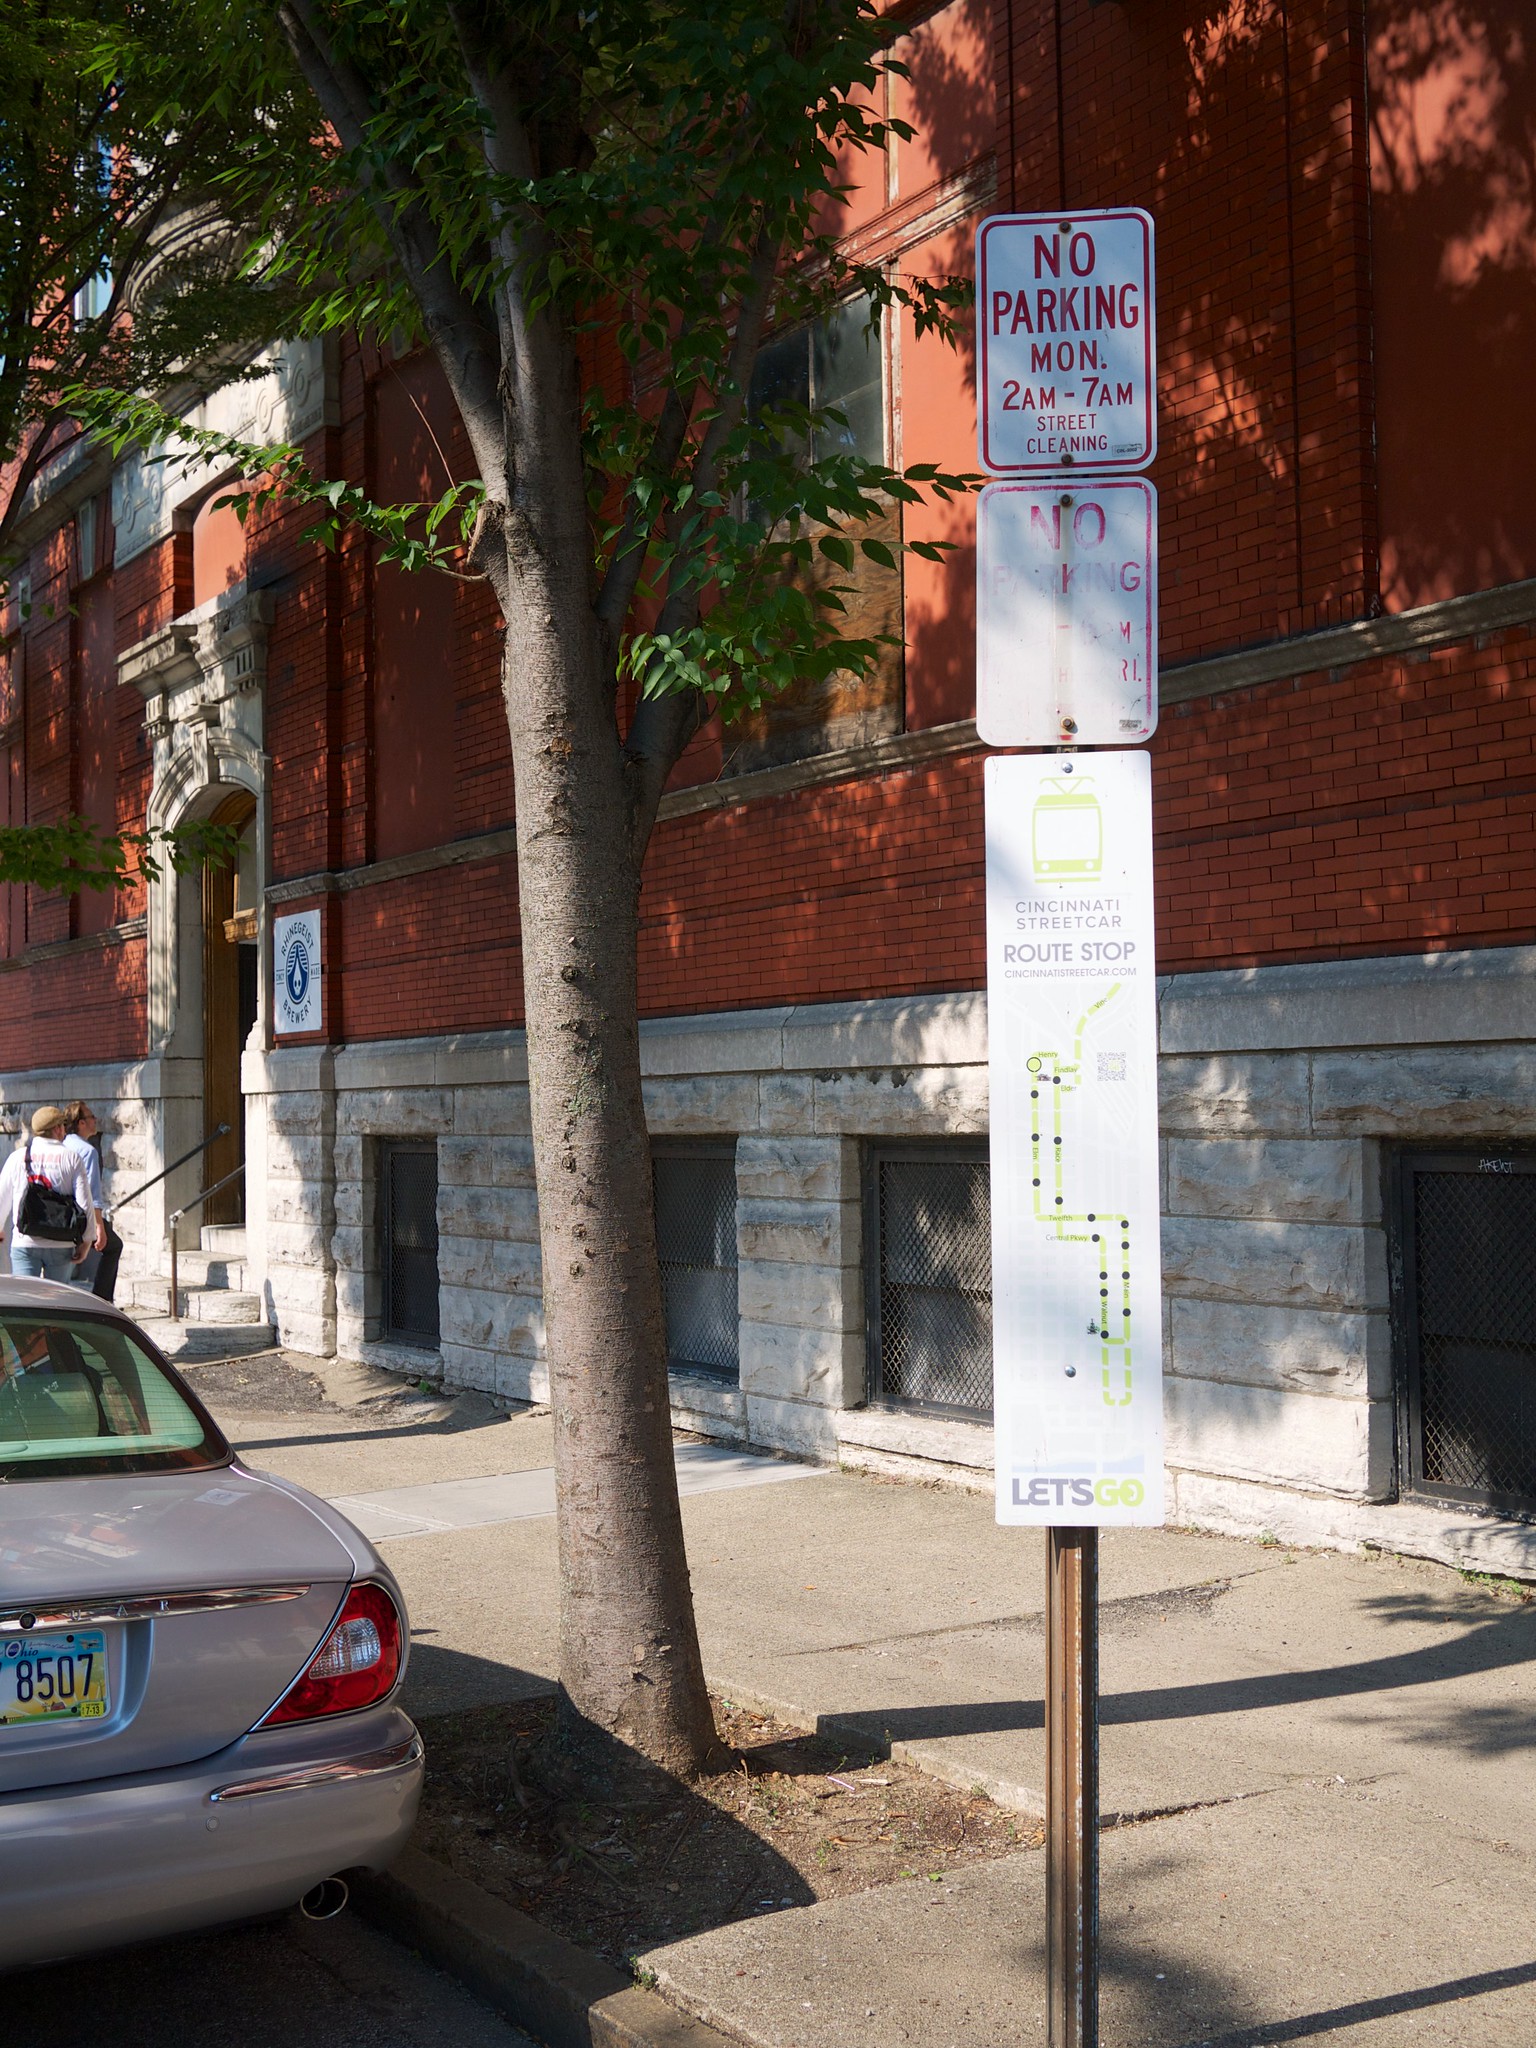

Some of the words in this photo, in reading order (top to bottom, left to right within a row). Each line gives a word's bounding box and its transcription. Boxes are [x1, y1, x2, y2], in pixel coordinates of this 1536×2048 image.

[1033, 231, 1096, 279] NO
[992, 282, 1139, 336] PARKING
[1030, 339, 1108, 373] MON.
[1036, 413, 1097, 432] STREET
[1026, 434, 1108, 454] CLEANING
[1029, 501, 1107, 551] NO
[992, 560, 1142, 597] PRKING
[1016, 898, 1121, 914] CINCINNATI
[1016, 914, 1122, 930] STREETCAR
[281, 922, 314, 957] RHINEGEIST
[1003, 943, 1073, 963] ROUTE
[1081, 941, 1136, 962] STOP
[1004, 967, 1137, 979] CINCINNATISTREETCAR.COM
[282, 994, 312, 1024] BREWERY
[1038, 1051, 1059, 1059] Henry
[16, 1653, 94, 1702] 8507
